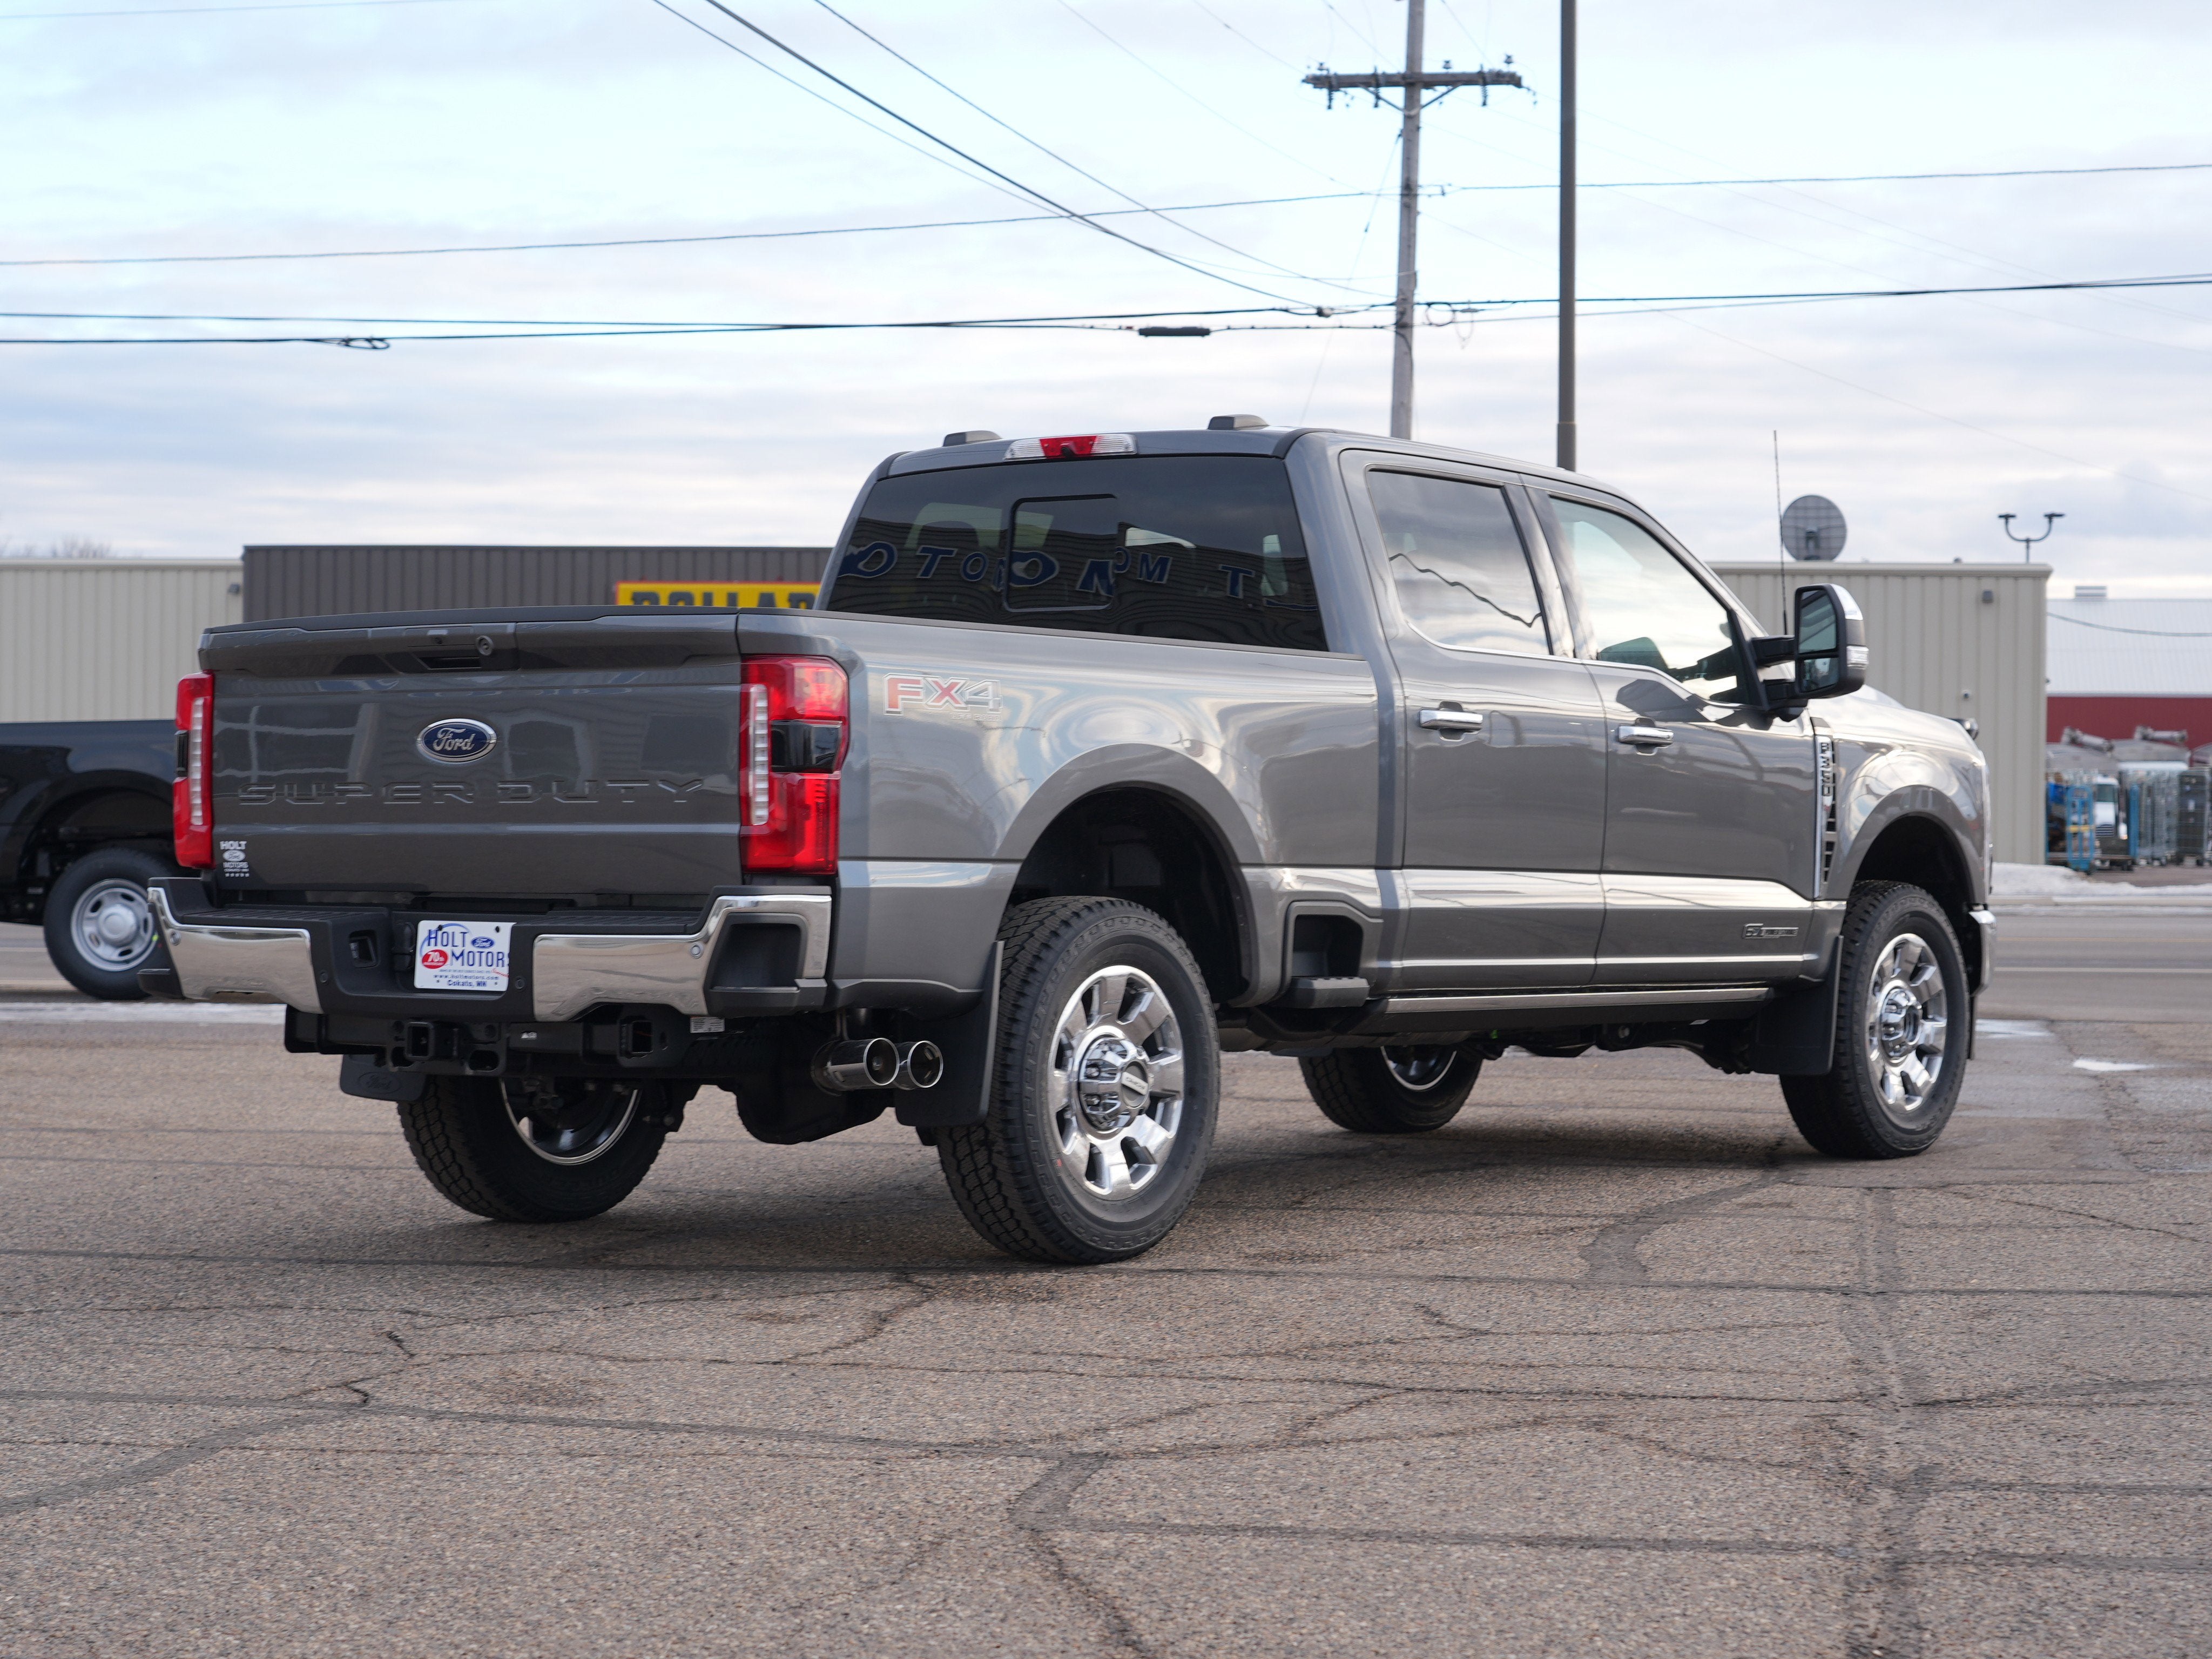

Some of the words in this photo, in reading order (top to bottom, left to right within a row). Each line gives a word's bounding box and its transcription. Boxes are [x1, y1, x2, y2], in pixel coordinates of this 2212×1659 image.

[883, 673, 1003, 716] FX4
[950, 712, 972, 720] OFF
[973, 713, 1002, 722] ROAD
[433, 727, 476, 751] Ford
[238, 782, 474, 805] SUPER
[497, 780, 703, 804] DUTY
[220, 841, 247, 850] HOLT
[427, 929, 468, 947] HOLT
[474, 938, 491, 947] Ford
[450, 949, 510, 967] MOTOR
